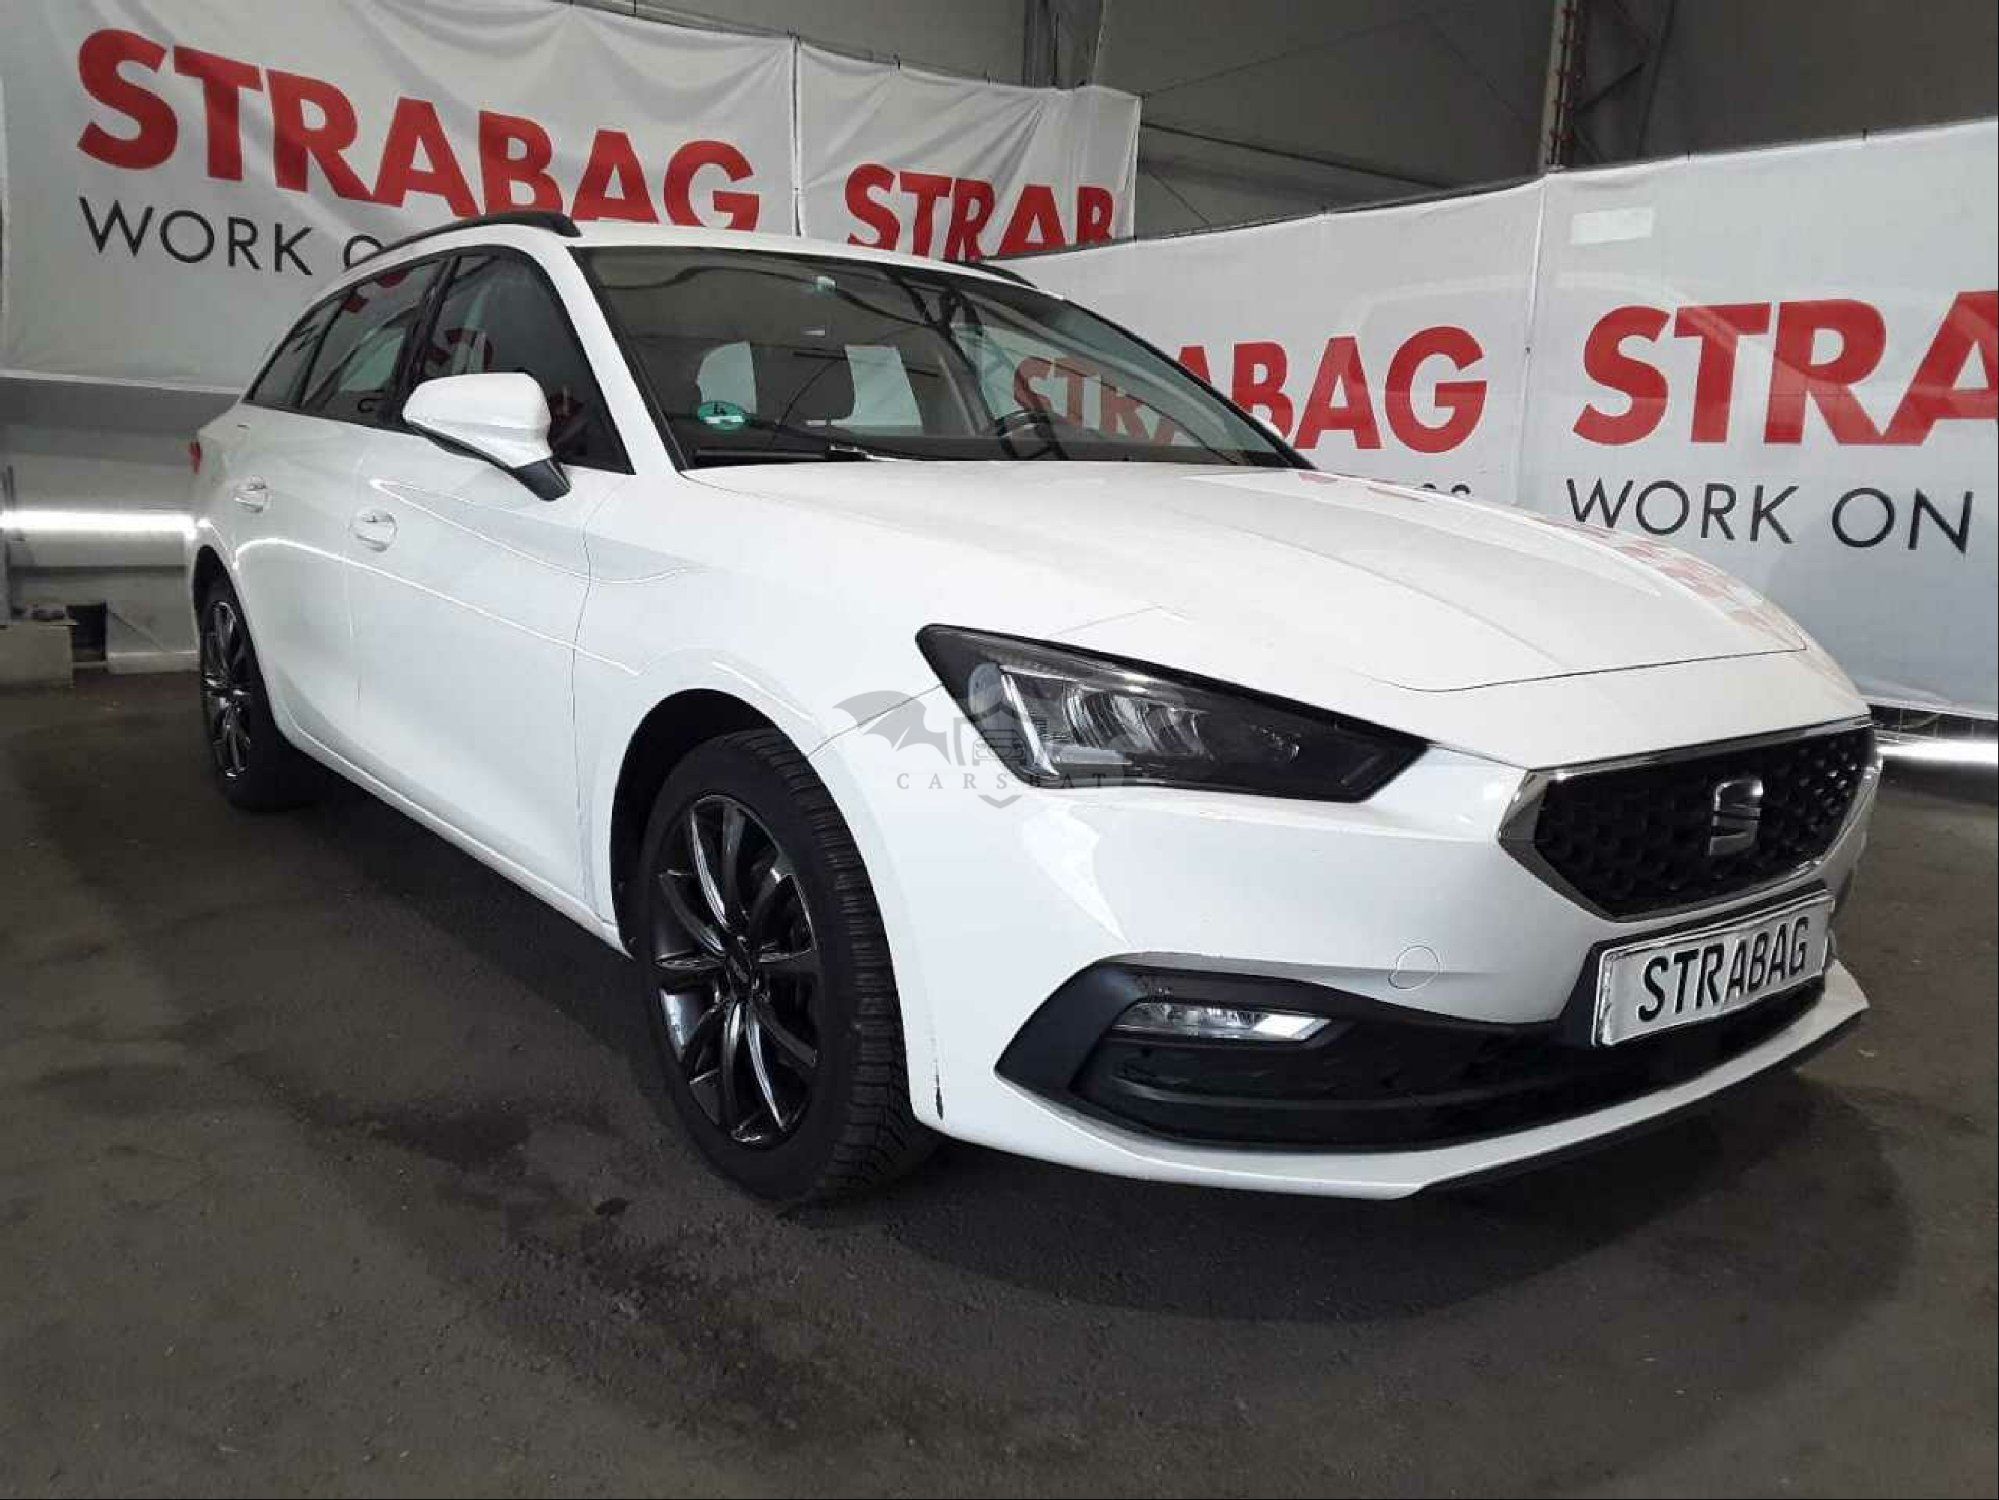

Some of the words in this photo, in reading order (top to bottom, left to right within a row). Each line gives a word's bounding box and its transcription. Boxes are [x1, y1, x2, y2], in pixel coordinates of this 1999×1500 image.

[77, 28, 761, 232] STRABAG
[80, 197, 312, 276] WORK
[1573, 290, 1998, 446] STRA
[1566, 478, 1801, 544] WORK
[1832, 487, 1973, 554] ON
[1638, 916, 1809, 1022] STRABAG
